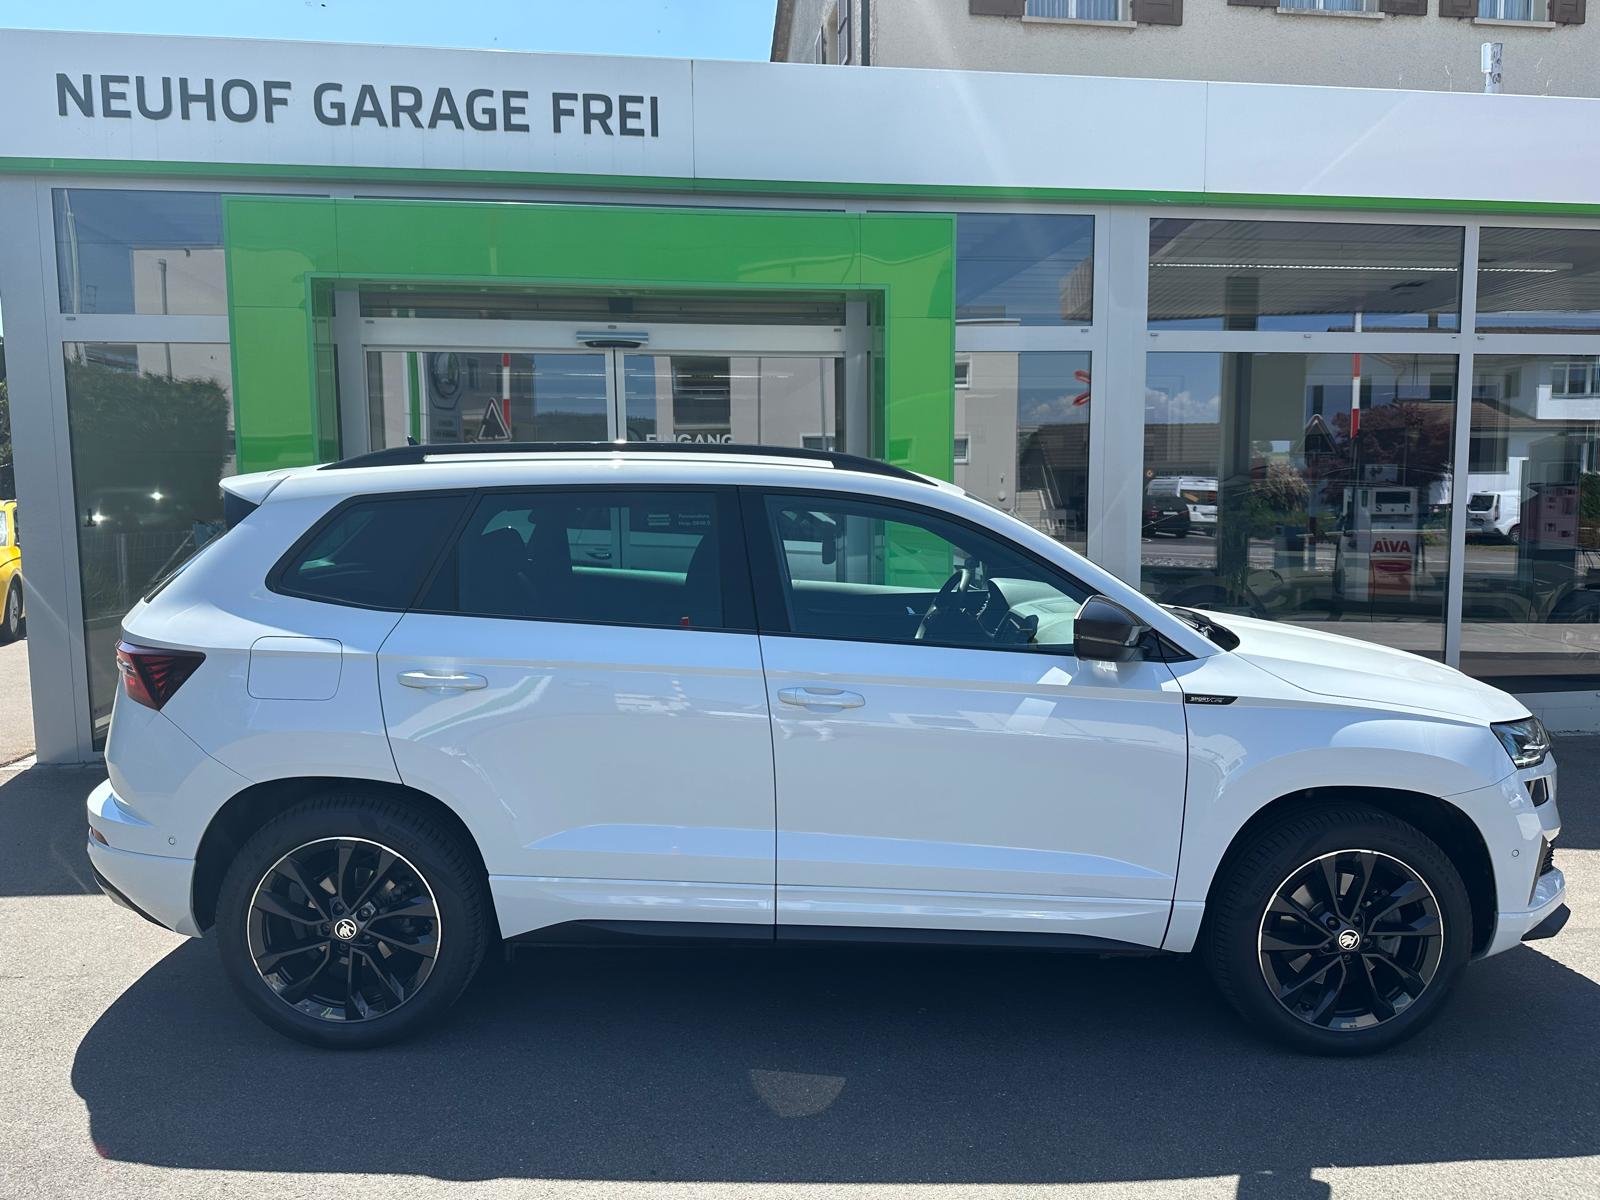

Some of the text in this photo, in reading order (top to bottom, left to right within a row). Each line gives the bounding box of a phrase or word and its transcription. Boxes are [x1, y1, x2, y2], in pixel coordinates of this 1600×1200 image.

[56, 72, 660, 138] NEUHOF GARAGE FREI
[645, 433, 736, 444] EINGANG
